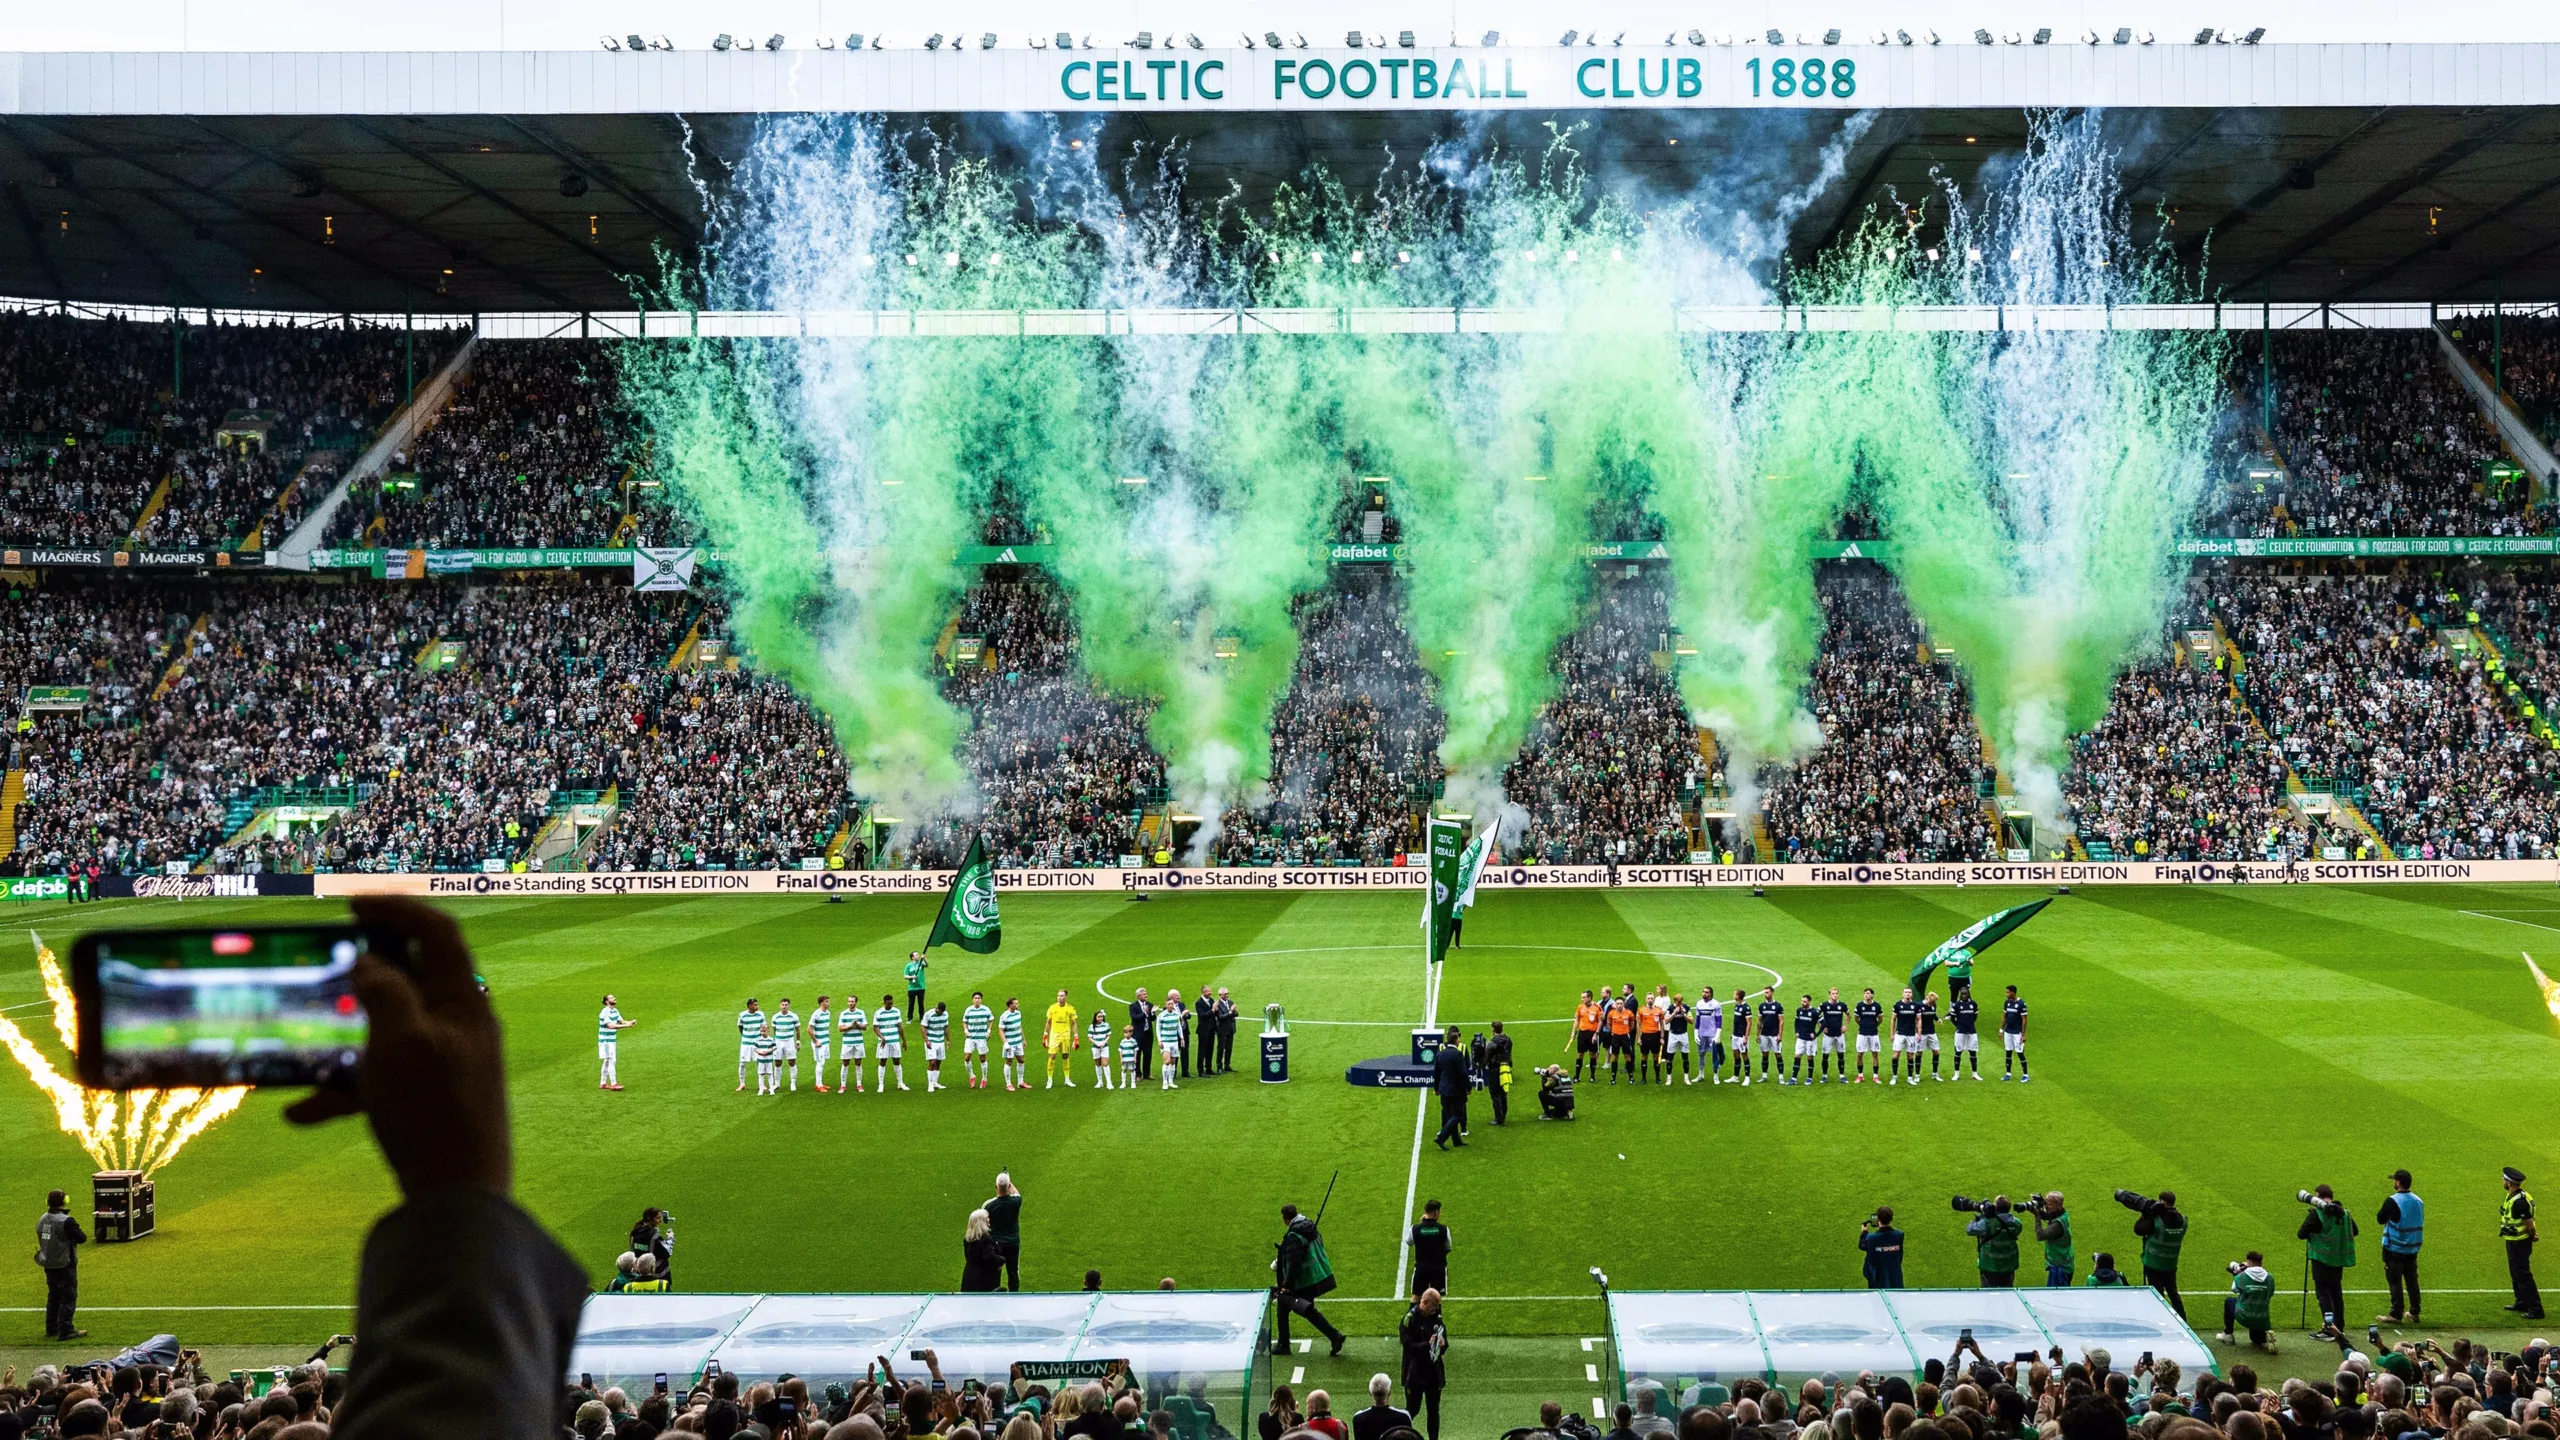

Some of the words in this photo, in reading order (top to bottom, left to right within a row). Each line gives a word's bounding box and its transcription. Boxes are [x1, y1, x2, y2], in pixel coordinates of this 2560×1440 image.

[1060, 59, 1224, 100] CELTIC
[1274, 57, 1527, 99] FOOTBALL
[1576, 57, 1703, 97] CLUB
[1744, 56, 1857, 97] 1888
[1331, 545, 1388, 560] dafabet
[2178, 540, 2233, 554] dafabet
[2269, 541, 2294, 553] CELTIC
[2295, 541, 2304, 552] FC
[2306, 541, 2354, 552] FOUNDATION
[2372, 541, 2409, 552] FOOTBALL
[2411, 541, 2426, 552] FOR
[2428, 541, 2449, 552] GOOD
[2469, 540, 2492, 552] CELTIC
[2493, 540, 2503, 551] FC
[2504, 540, 2552, 552] FOUNDATION
[32, 552, 101, 563] MAGNERS
[139, 553, 205, 564] MAGNERS
[345, 551, 369, 564] CELTIC
[487, 551, 505, 564] FOR
[506, 551, 527, 564] GOOD
[546, 552, 571, 563] CELTIC
[573, 552, 582, 563] FC
[584, 552, 632, 563] FOUNDATION
[1628, 869, 1712, 883] SCOTTISH
[1717, 868, 1784, 881] EDITION
[1811, 867, 1851, 881] Final
[1894, 866, 1966, 883] Standing
[1971, 867, 2056, 880] SCOTTISH
[2061, 866, 2127, 879] EDITION
[2155, 865, 2196, 879] Final
[2315, 865, 2399, 878] SCOTTISH
[2404, 864, 2470, 878] EDITION
[133, 874, 214, 897] William
[214, 875, 259, 896] HILL
[429, 877, 471, 891] Final
[513, 878, 586, 893] Standing
[591, 877, 676, 889] SCOTTISH
[681, 876, 749, 889] EDITION
[776, 874, 817, 888] Final
[860, 875, 932, 890] Standing
[938, 873, 1022, 888] SCISH
[1028, 873, 1094, 887] EDITION
[959, 872, 974, 889] THE
[1122, 872, 1163, 886] Final
[1205, 872, 1278, 888] Standing
[1283, 872, 1367, 885] SCOTTISH
[1373, 871, 1426, 885] EDITIO
[965, 925, 981, 936] 1888
[1404, 1075, 1435, 1085] Champi
